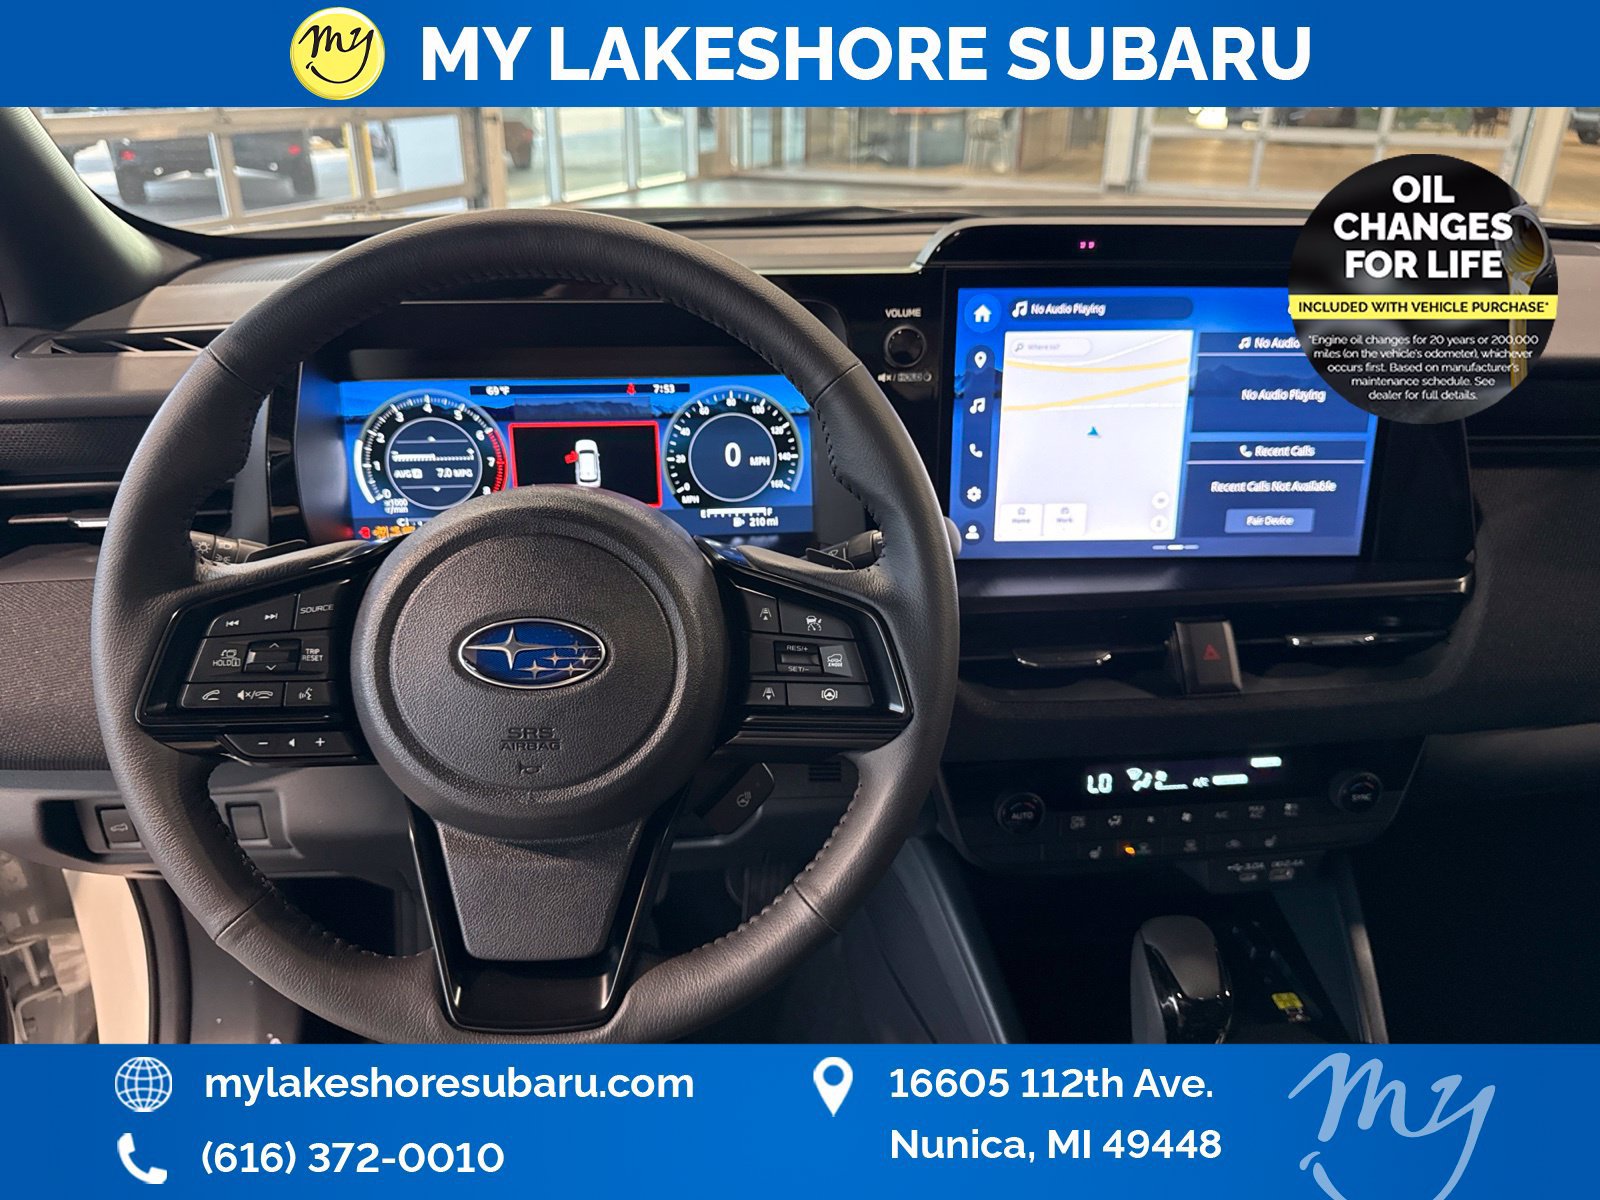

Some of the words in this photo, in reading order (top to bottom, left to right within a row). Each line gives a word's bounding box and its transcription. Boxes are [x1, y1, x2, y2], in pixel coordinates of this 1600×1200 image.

[885, 307, 922, 318] VOLUME
[1030, 303, 1045, 314] No
[1045, 302, 1072, 314] Audio
[1073, 302, 1106, 316] Playing
[1254, 336, 1270, 349] No
[1271, 336, 1301, 349] Audio
[652, 383, 675, 394] 7:53
[1241, 388, 1257, 401] No
[1258, 388, 1288, 401] Audio
[1289, 388, 1327, 403] Playing
[725, 397, 737, 407] 80
[422, 403, 433, 414] 4
[751, 404, 765, 415] 100
[394, 411, 405, 423] 3
[453, 408, 463, 421] 5
[475, 429, 485, 441] 6
[679, 426, 691, 437] 40
[770, 425, 784, 435] 120
[375, 432, 386, 443] 2
[724, 441, 742, 468] 0
[749, 456, 771, 467] MPH
[777, 451, 792, 462] 140
[1255, 445, 1290, 457] Recent
[1290, 445, 1316, 457] Calls
[486, 456, 496, 467] 7
[675, 454, 686, 464] 20
[372, 460, 381, 471] 1
[683, 482, 691, 492] 0
[770, 479, 784, 489] 160
[1211, 481, 1246, 493] Recent
[1246, 481, 1271, 493] Calls
[1271, 481, 1291, 492] Not
[1291, 480, 1337, 493] Available
[681, 495, 700, 504] MPH
[749, 517, 766, 527] 210
[766, 516, 779, 527] mi
[1265, 516, 1294, 526] Device
[299, 603, 335, 615] SOURCE
[212, 659, 231, 667] HOLD
[301, 654, 324, 662] RESET
[507, 727, 556, 739] SRS
[500, 742, 561, 751] AIRBAG
[1011, 811, 1034, 821] AUTO
